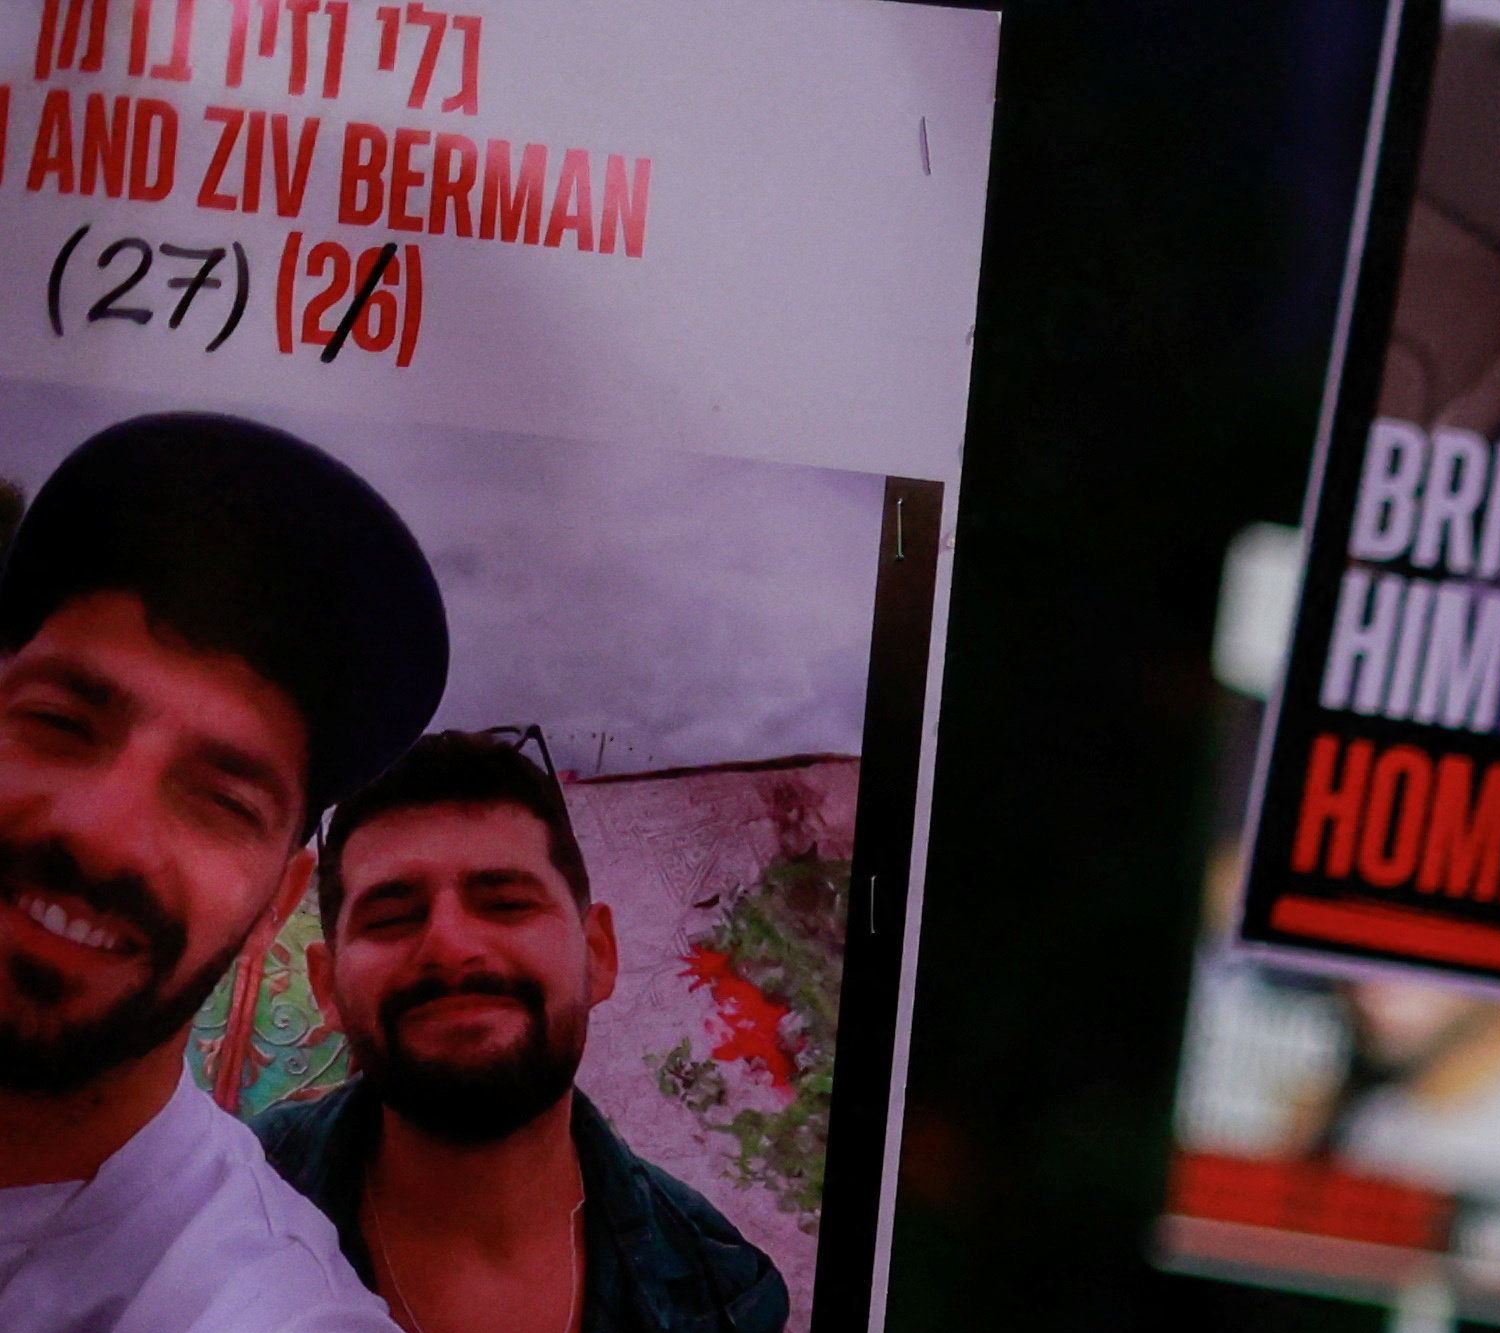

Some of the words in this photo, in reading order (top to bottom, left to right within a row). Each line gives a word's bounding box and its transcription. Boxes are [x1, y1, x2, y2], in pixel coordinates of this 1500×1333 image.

[377, 2, 482, 116] גלי
[26, 88, 179, 202] AND
[196, 106, 320, 218] ZIV
[337, 123, 652, 258] BERMAN
[47, 224, 250, 352] (27)
